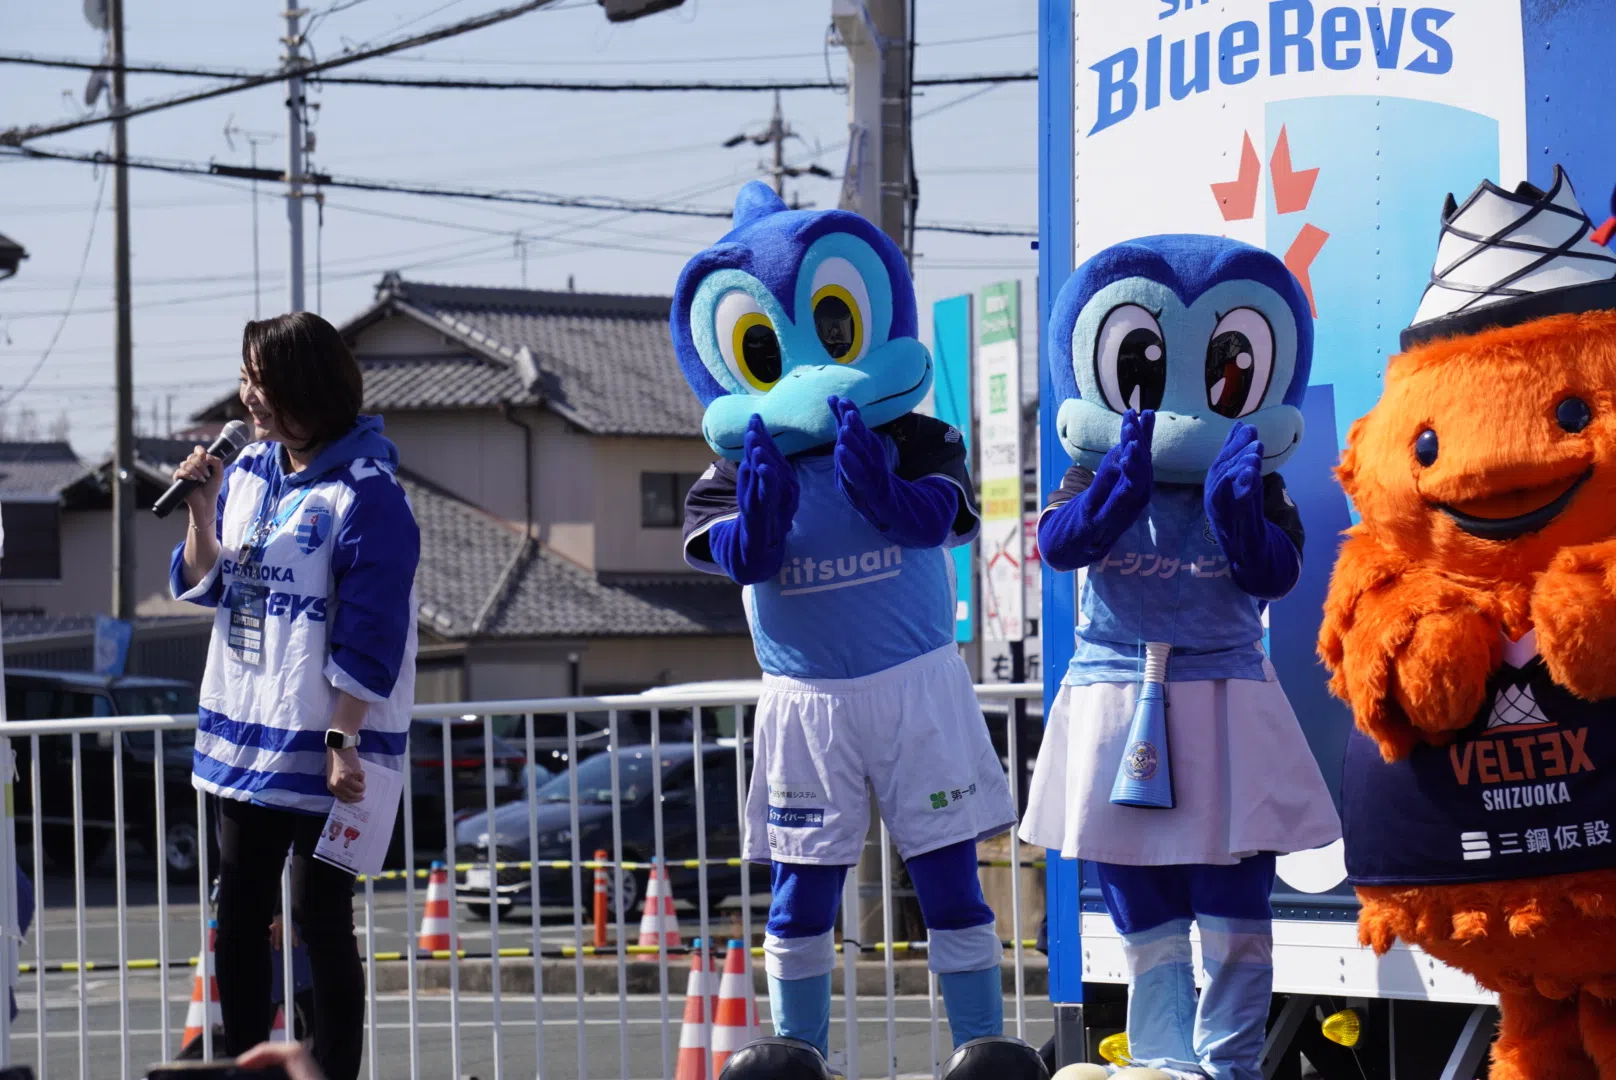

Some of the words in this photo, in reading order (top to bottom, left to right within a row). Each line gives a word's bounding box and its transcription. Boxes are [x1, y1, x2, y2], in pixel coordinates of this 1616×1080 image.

[1087, 1, 1455, 138] BlueRevs
[780, 546, 902, 585] ritsuan
[1450, 727, 1596, 785] VELTEX
[1482, 781, 1571, 811] SHIZUOKA
[1498, 820, 1612, 854] 三鋼仮設
